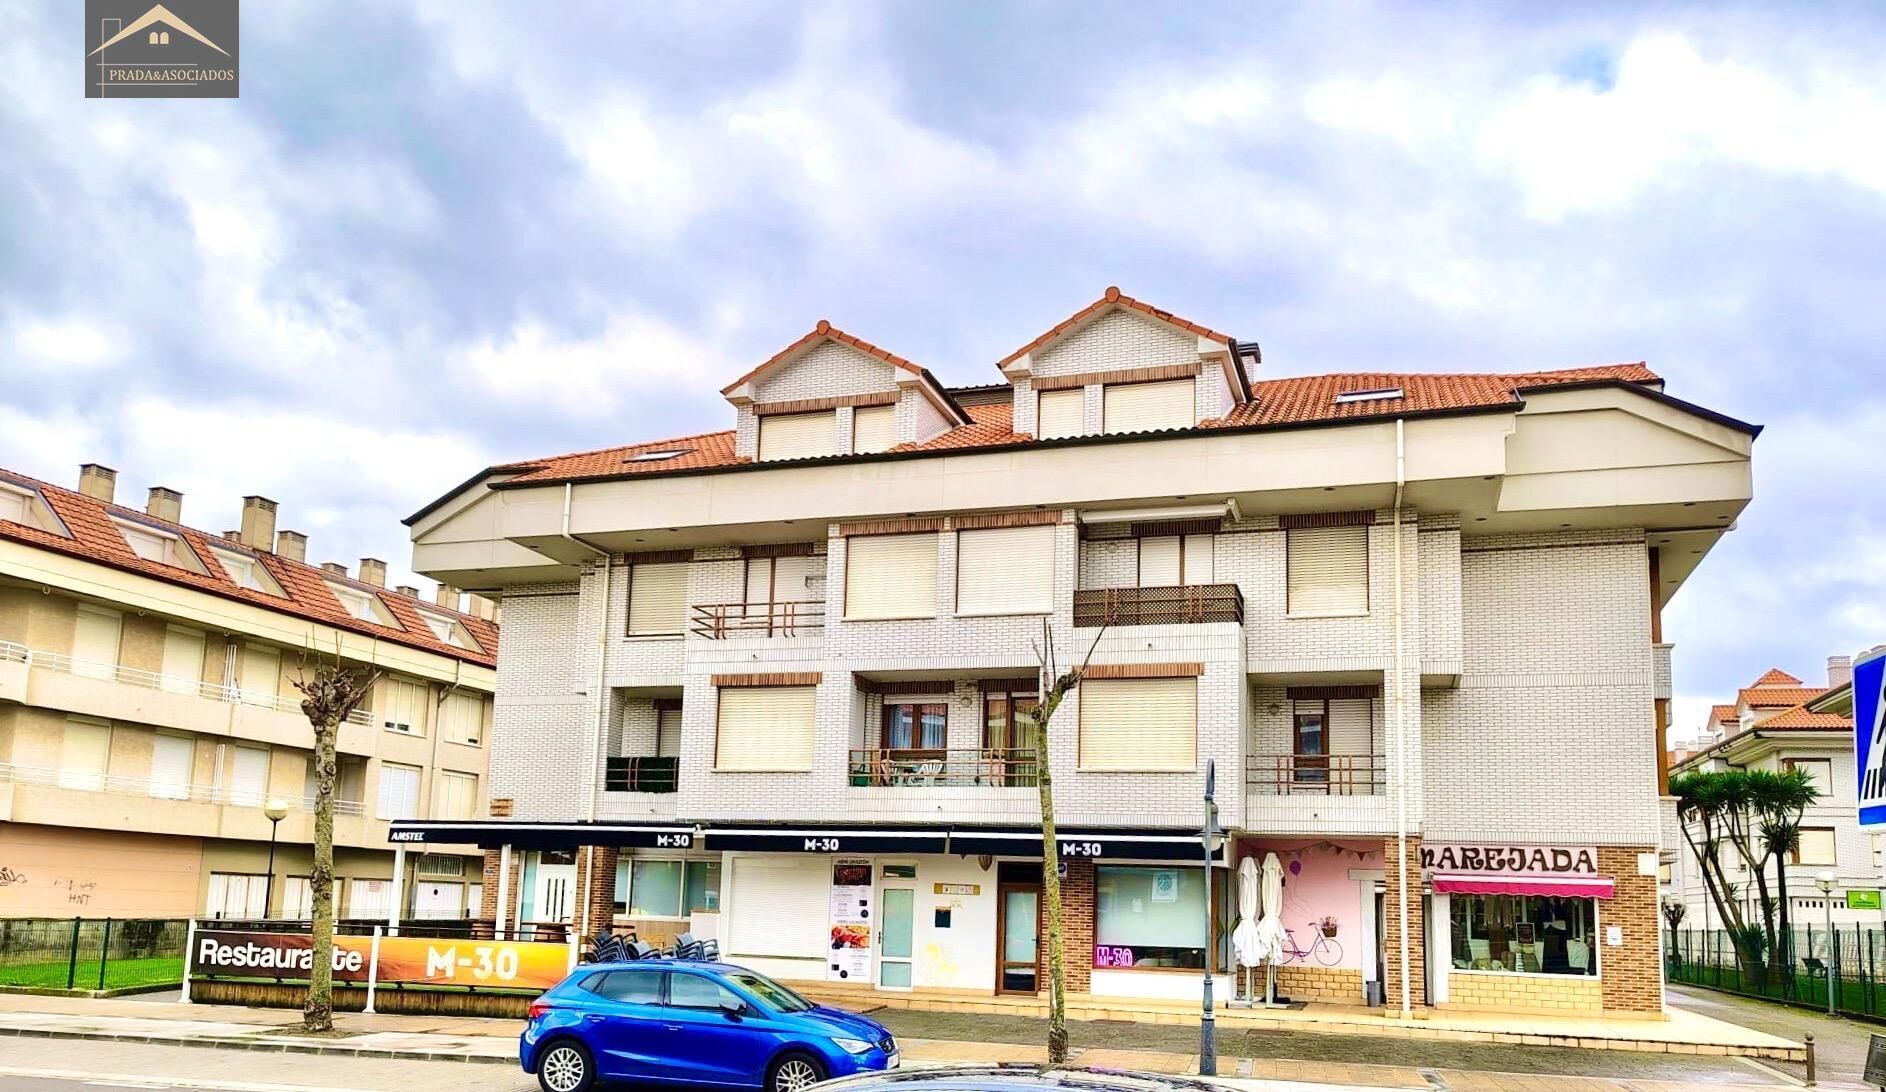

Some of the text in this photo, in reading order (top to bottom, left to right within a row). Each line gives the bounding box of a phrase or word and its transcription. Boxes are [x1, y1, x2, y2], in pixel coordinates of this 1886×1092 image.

[391, 831, 425, 841] AMSTEL
[657, 834, 690, 847] M-30
[804, 838, 840, 851] M-30
[1062, 842, 1102, 856] M-30
[199, 938, 363, 972] Restaurate
[1096, 946, 1133, 967] M-30
[426, 945, 519, 981] M-30
